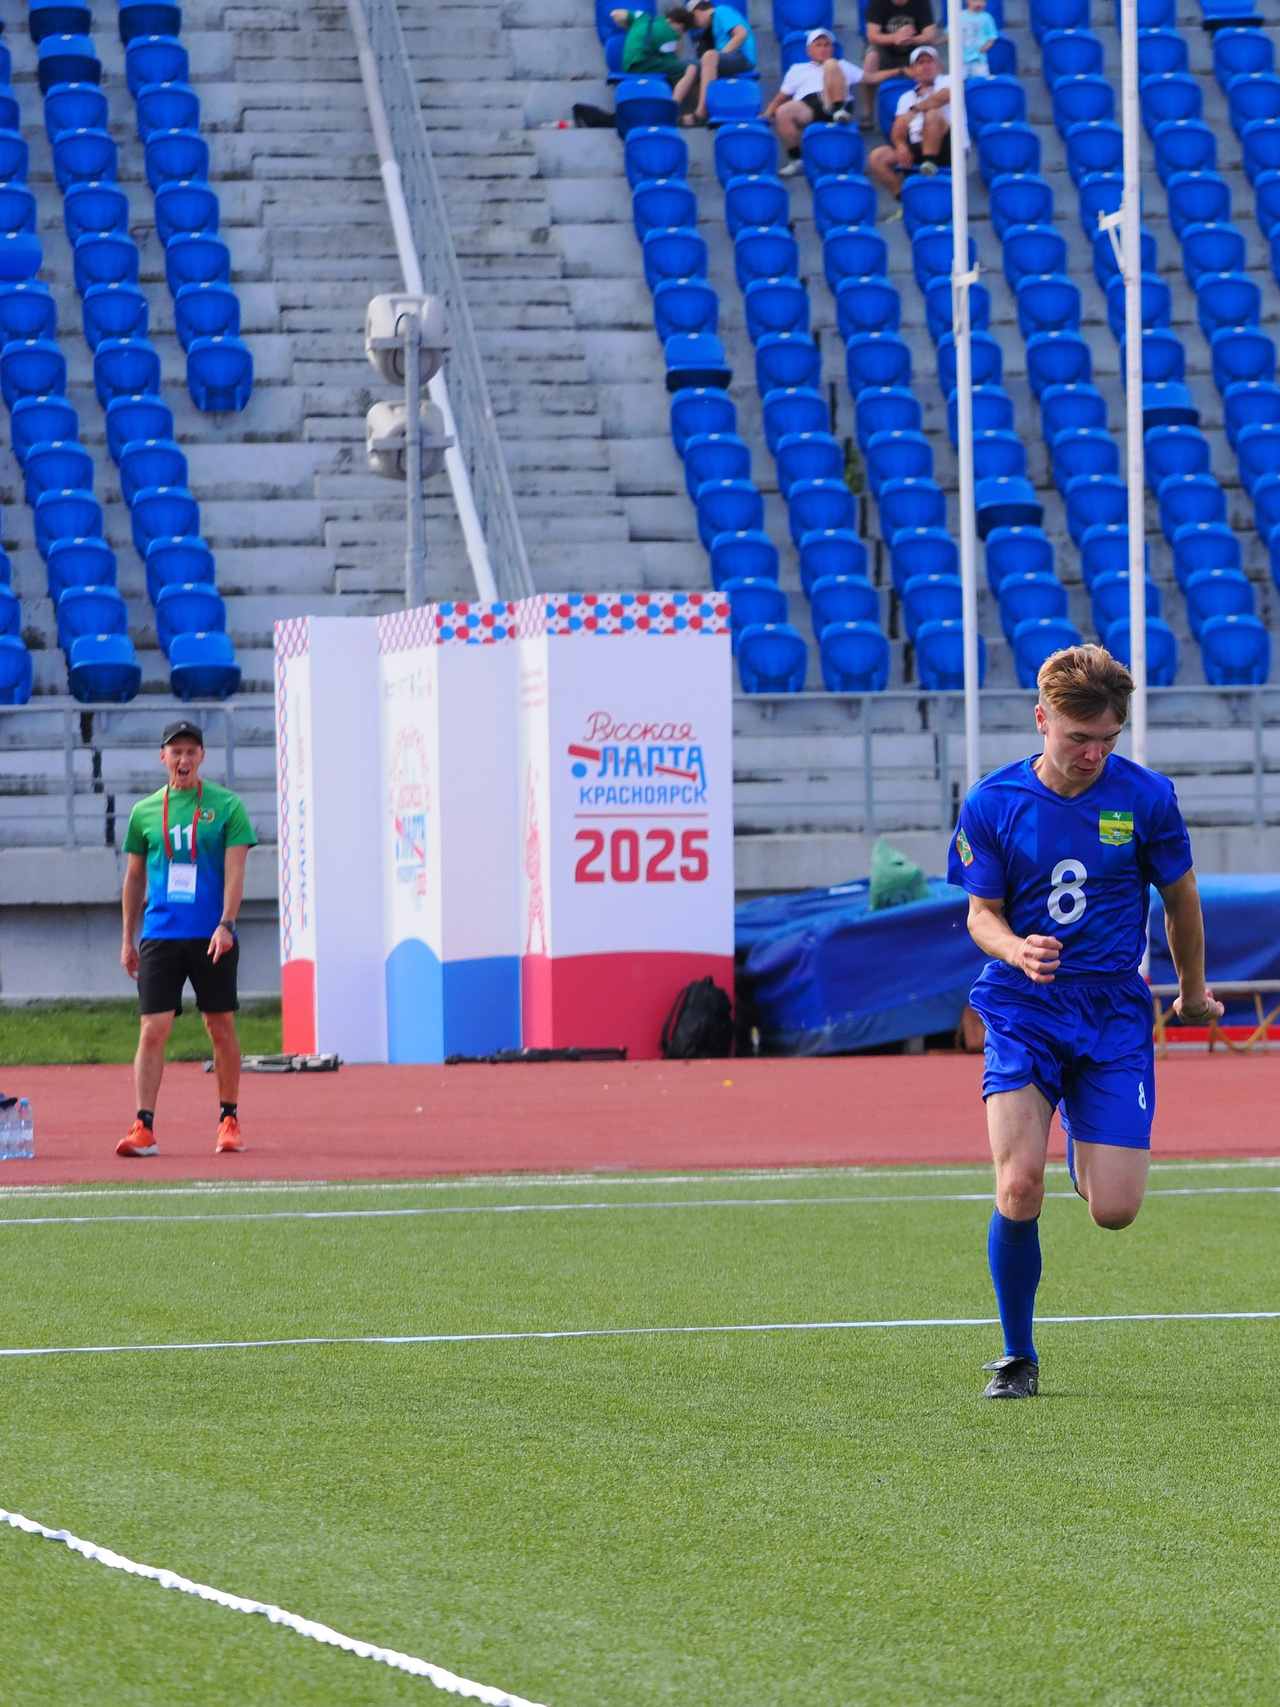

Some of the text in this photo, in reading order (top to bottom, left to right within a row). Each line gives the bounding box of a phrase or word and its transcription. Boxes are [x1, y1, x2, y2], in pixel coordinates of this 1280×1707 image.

[583, 711, 697, 742] Русская
[597, 745, 707, 788] ЛАПТА
[579, 785, 707, 804] КРАСНОЯРСК
[169, 824, 193, 850] 11
[574, 828, 709, 883] 2025
[1047, 858, 1087, 925] 8
[1138, 1081, 1147, 1110] 8
